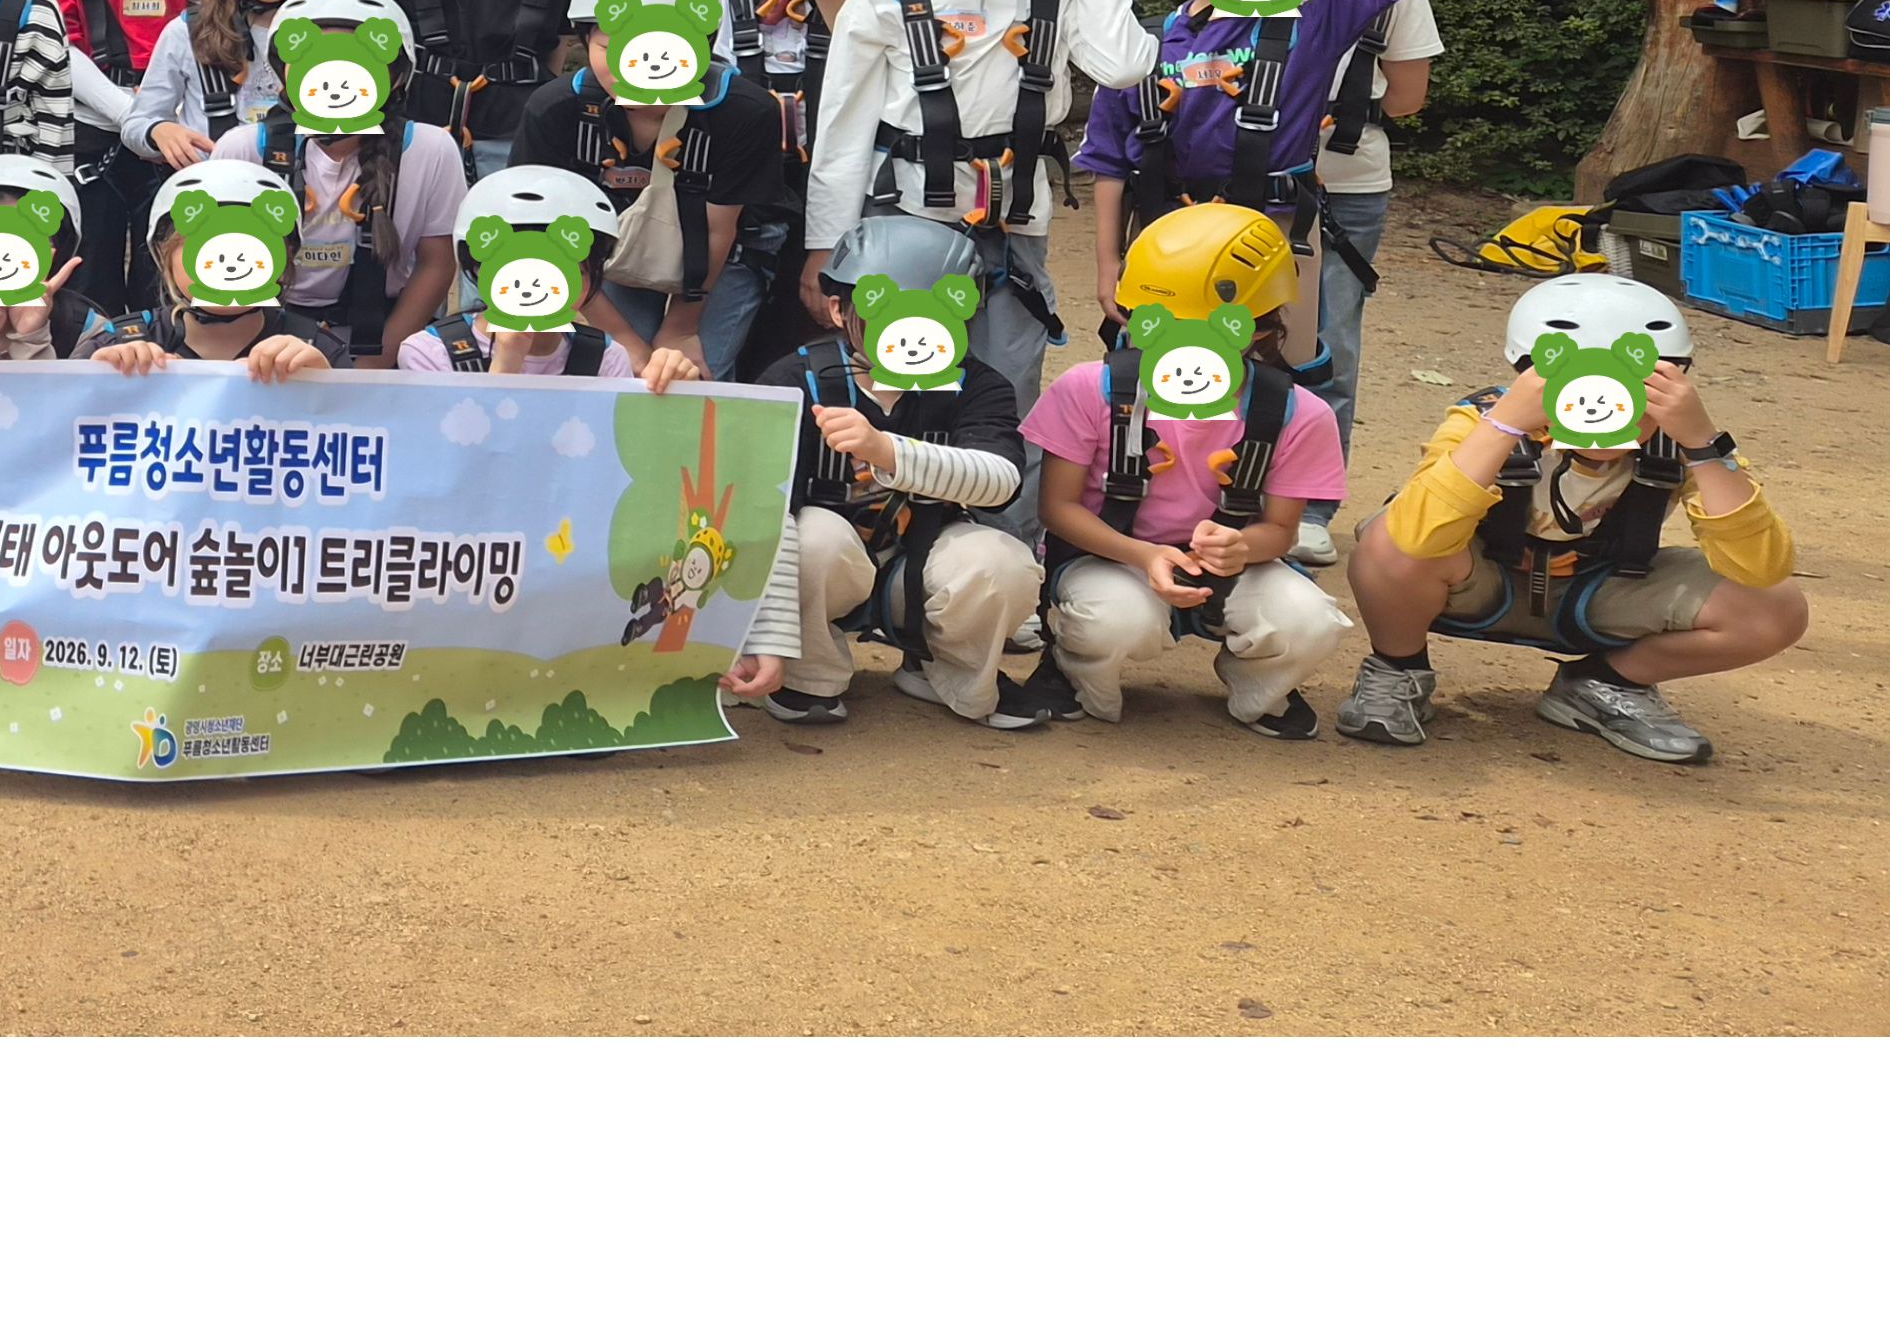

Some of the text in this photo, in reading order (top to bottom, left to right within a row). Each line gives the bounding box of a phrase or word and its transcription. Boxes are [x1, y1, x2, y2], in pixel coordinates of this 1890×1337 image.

[304, 250, 342, 262] 이다인
[77, 420, 385, 499] 푸름청소년활동센터
[42, 520, 178, 590] 아웃도어
[189, 527, 305, 598] 숲놀이]
[315, 535, 523, 606] 트리클라이밍
[3, 636, 32, 662] 일자
[44, 639, 179, 677] 2026. 9. 12. (토)
[299, 643, 406, 670] 너부대근린공원
[256, 651, 283, 674] 장소
[183, 735, 270, 757] 푸름청소년활동센터
